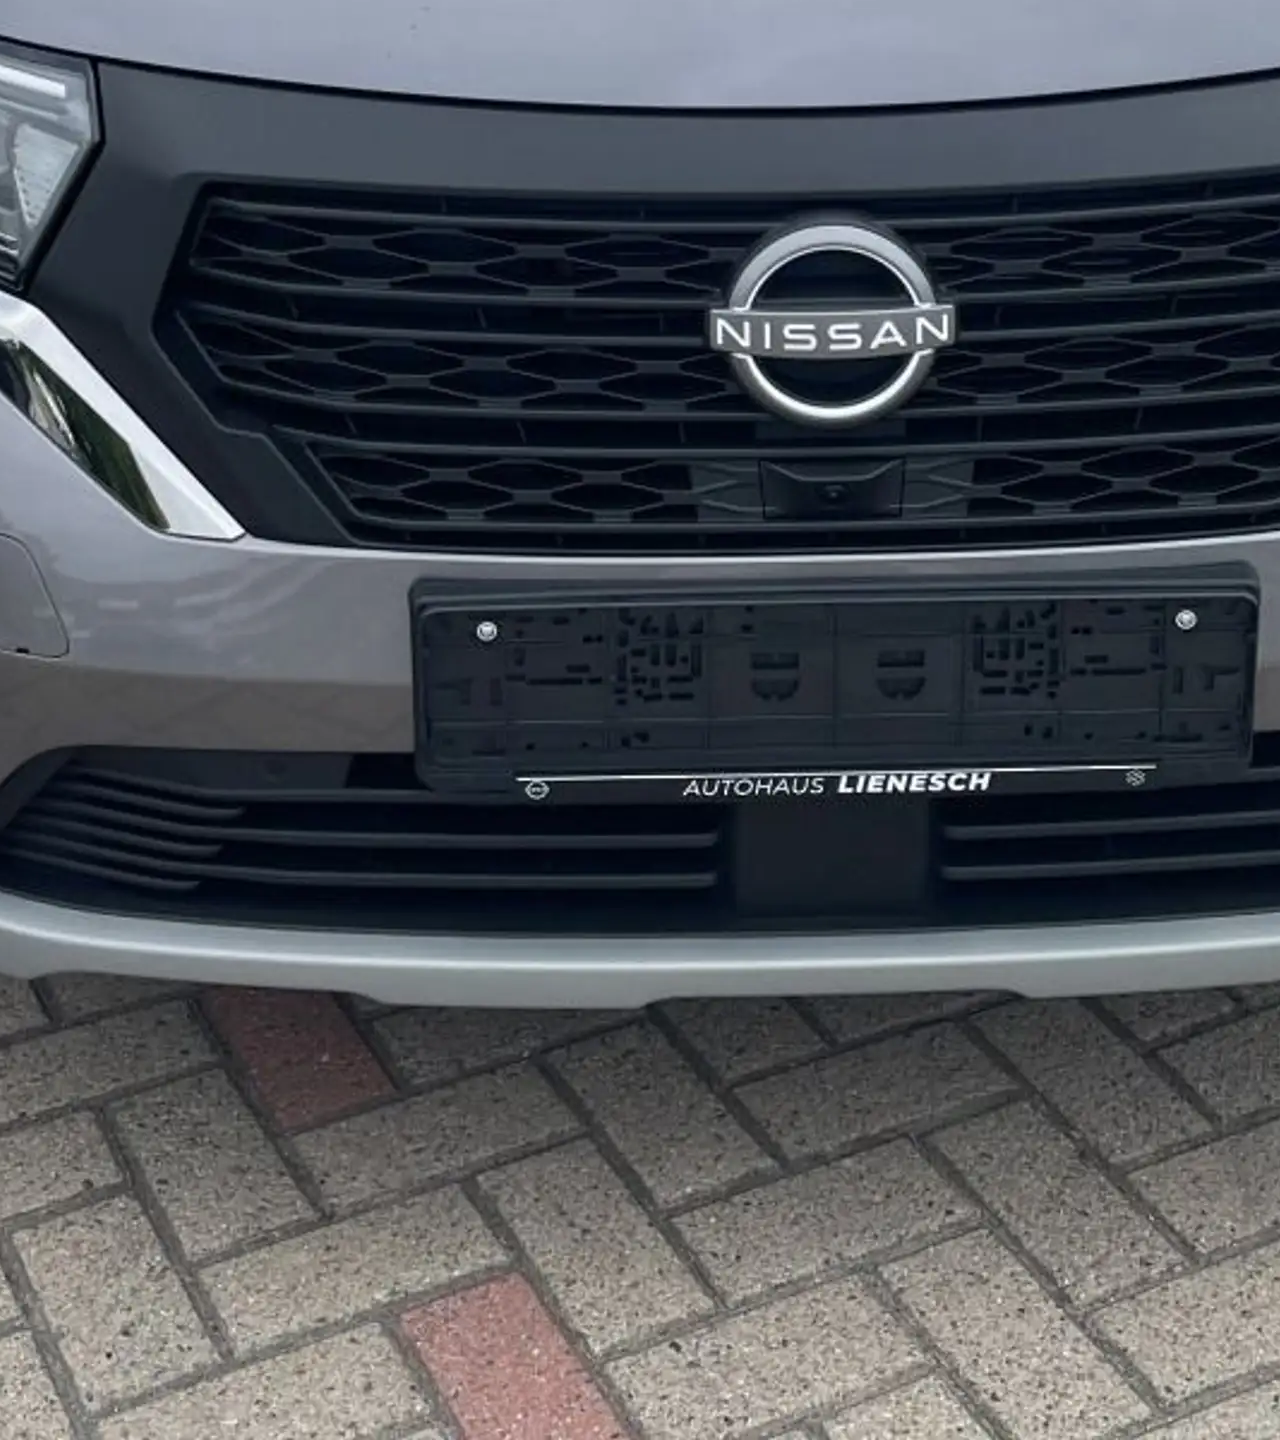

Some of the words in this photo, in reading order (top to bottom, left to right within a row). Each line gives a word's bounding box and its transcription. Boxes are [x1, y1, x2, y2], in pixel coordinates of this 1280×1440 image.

[715, 313, 949, 352] NISSAN
[682, 776, 825, 797] AUTOHAUS
[837, 771, 993, 794] LIENESCH
